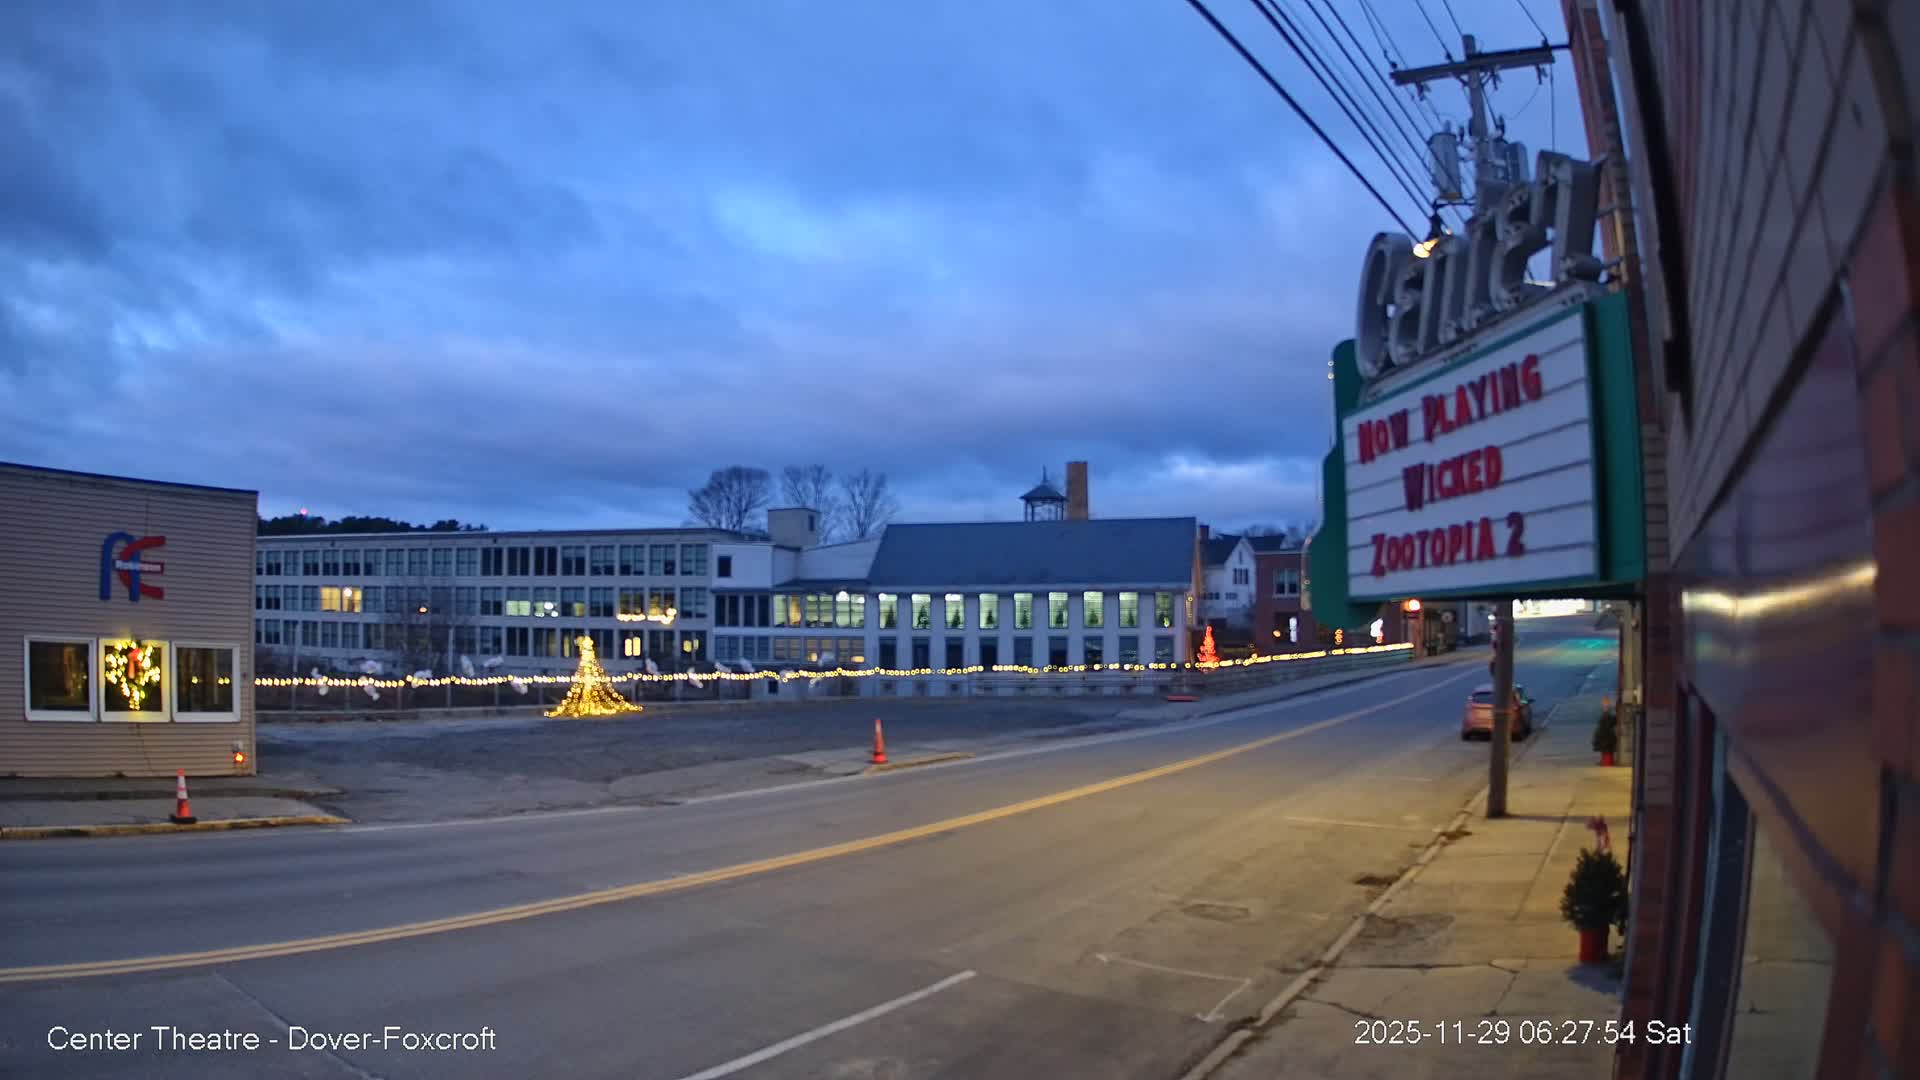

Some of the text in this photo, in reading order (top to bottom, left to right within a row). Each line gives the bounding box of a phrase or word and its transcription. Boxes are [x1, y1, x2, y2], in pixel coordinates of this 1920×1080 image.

[1357, 354, 1543, 464] NOW PLAYING
[1402, 445, 1502, 511] WICKED
[1371, 511, 1526, 578] ZOOTOPIA 2
